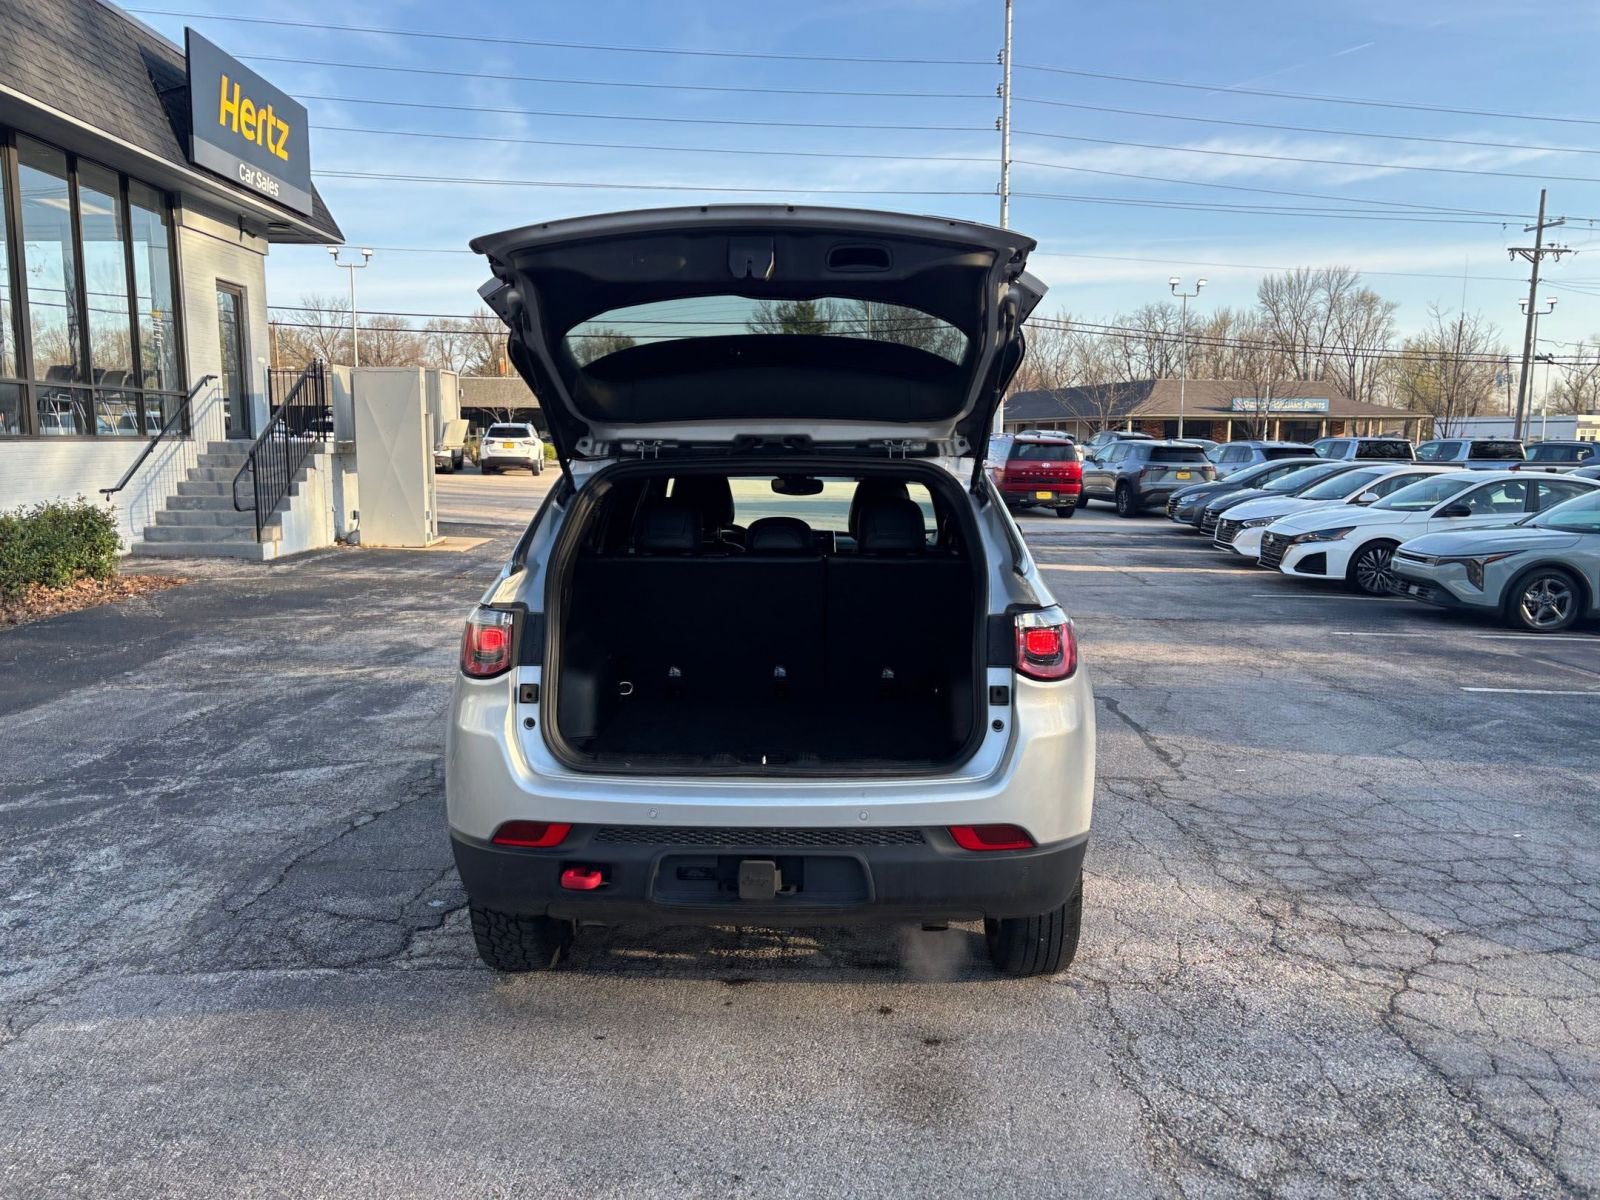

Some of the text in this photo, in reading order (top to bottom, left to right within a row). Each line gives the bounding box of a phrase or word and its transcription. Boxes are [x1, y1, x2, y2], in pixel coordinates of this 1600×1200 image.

[219, 74, 290, 161] Hertz
[239, 163, 279, 197] Car Sales
